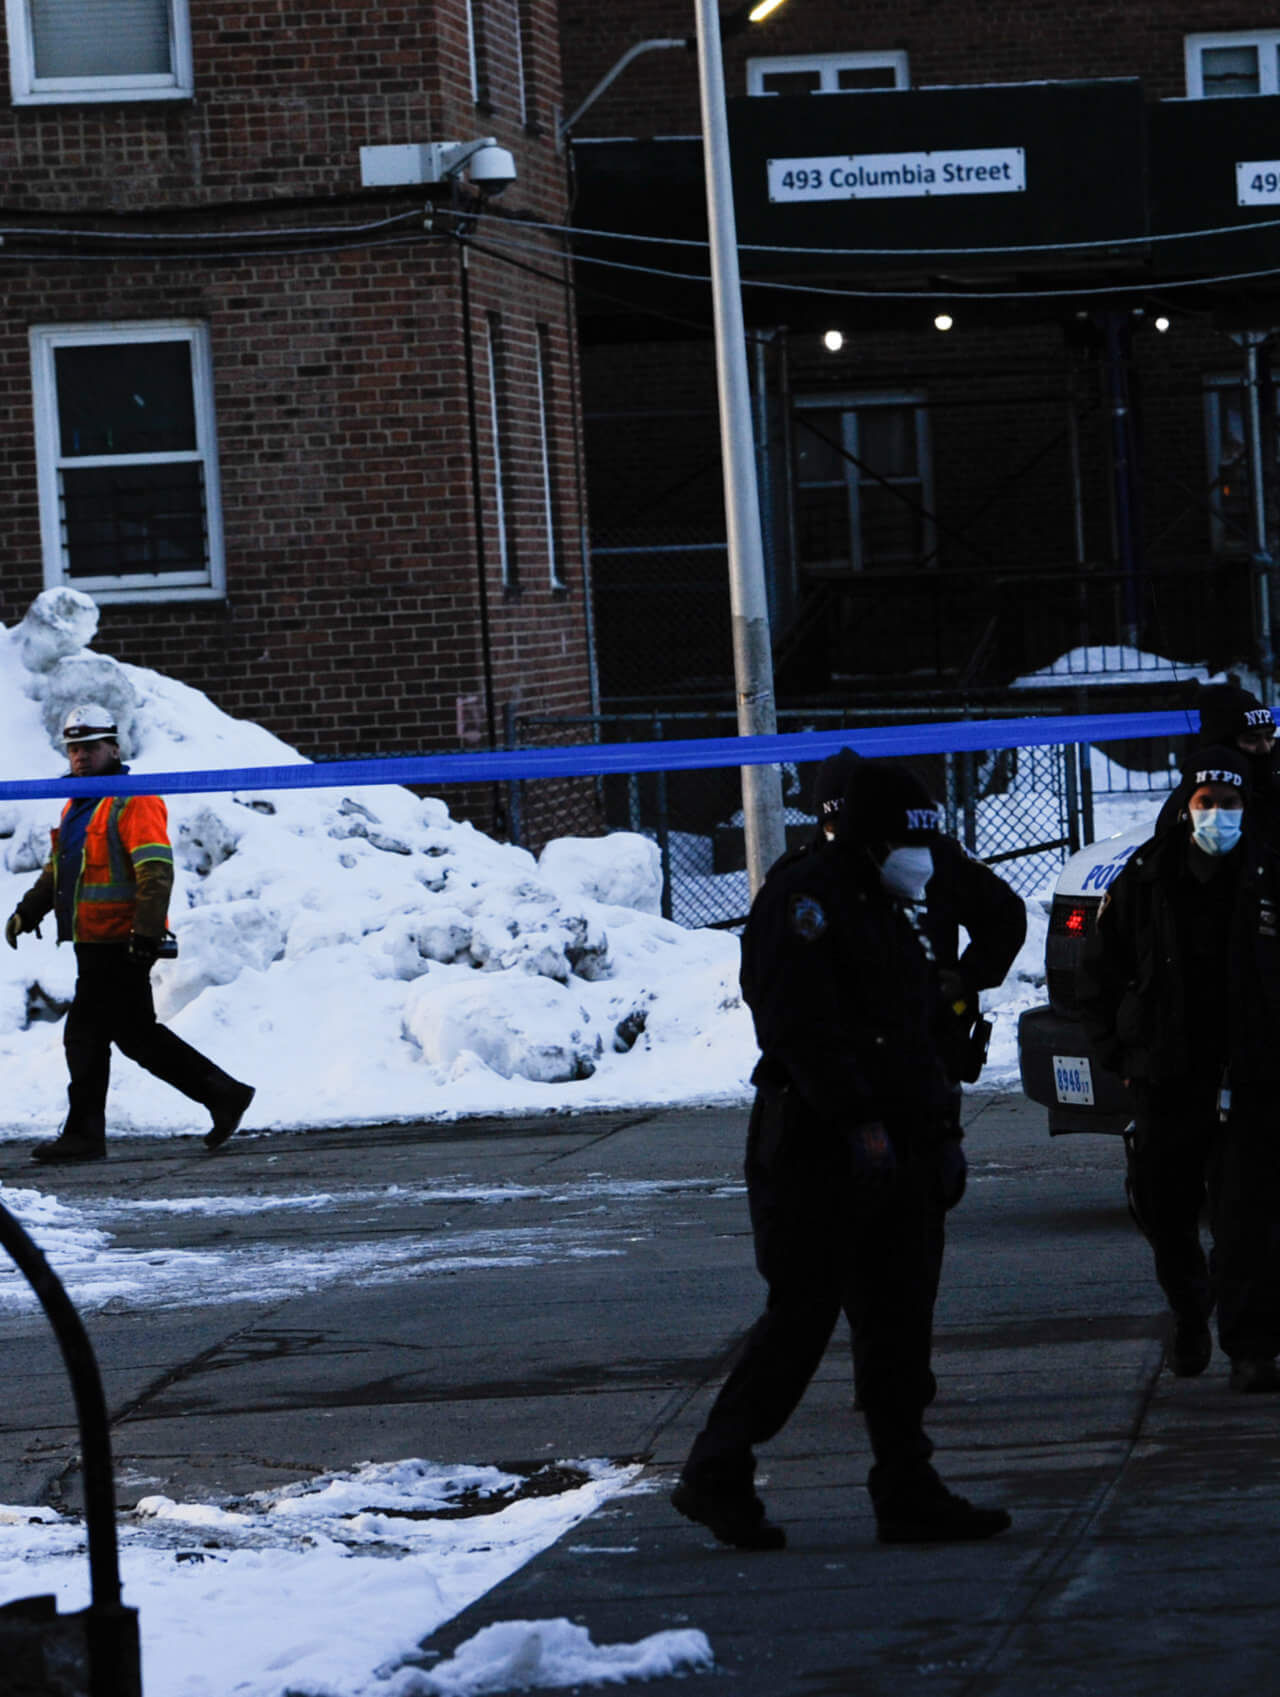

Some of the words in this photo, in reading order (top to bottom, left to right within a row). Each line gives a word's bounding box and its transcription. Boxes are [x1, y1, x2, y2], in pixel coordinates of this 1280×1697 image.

[782, 169, 822, 189] 493
[830, 164, 935, 188] Columbia
[942, 161, 1011, 182] Street
[1196, 769, 1243, 787] NYPD
